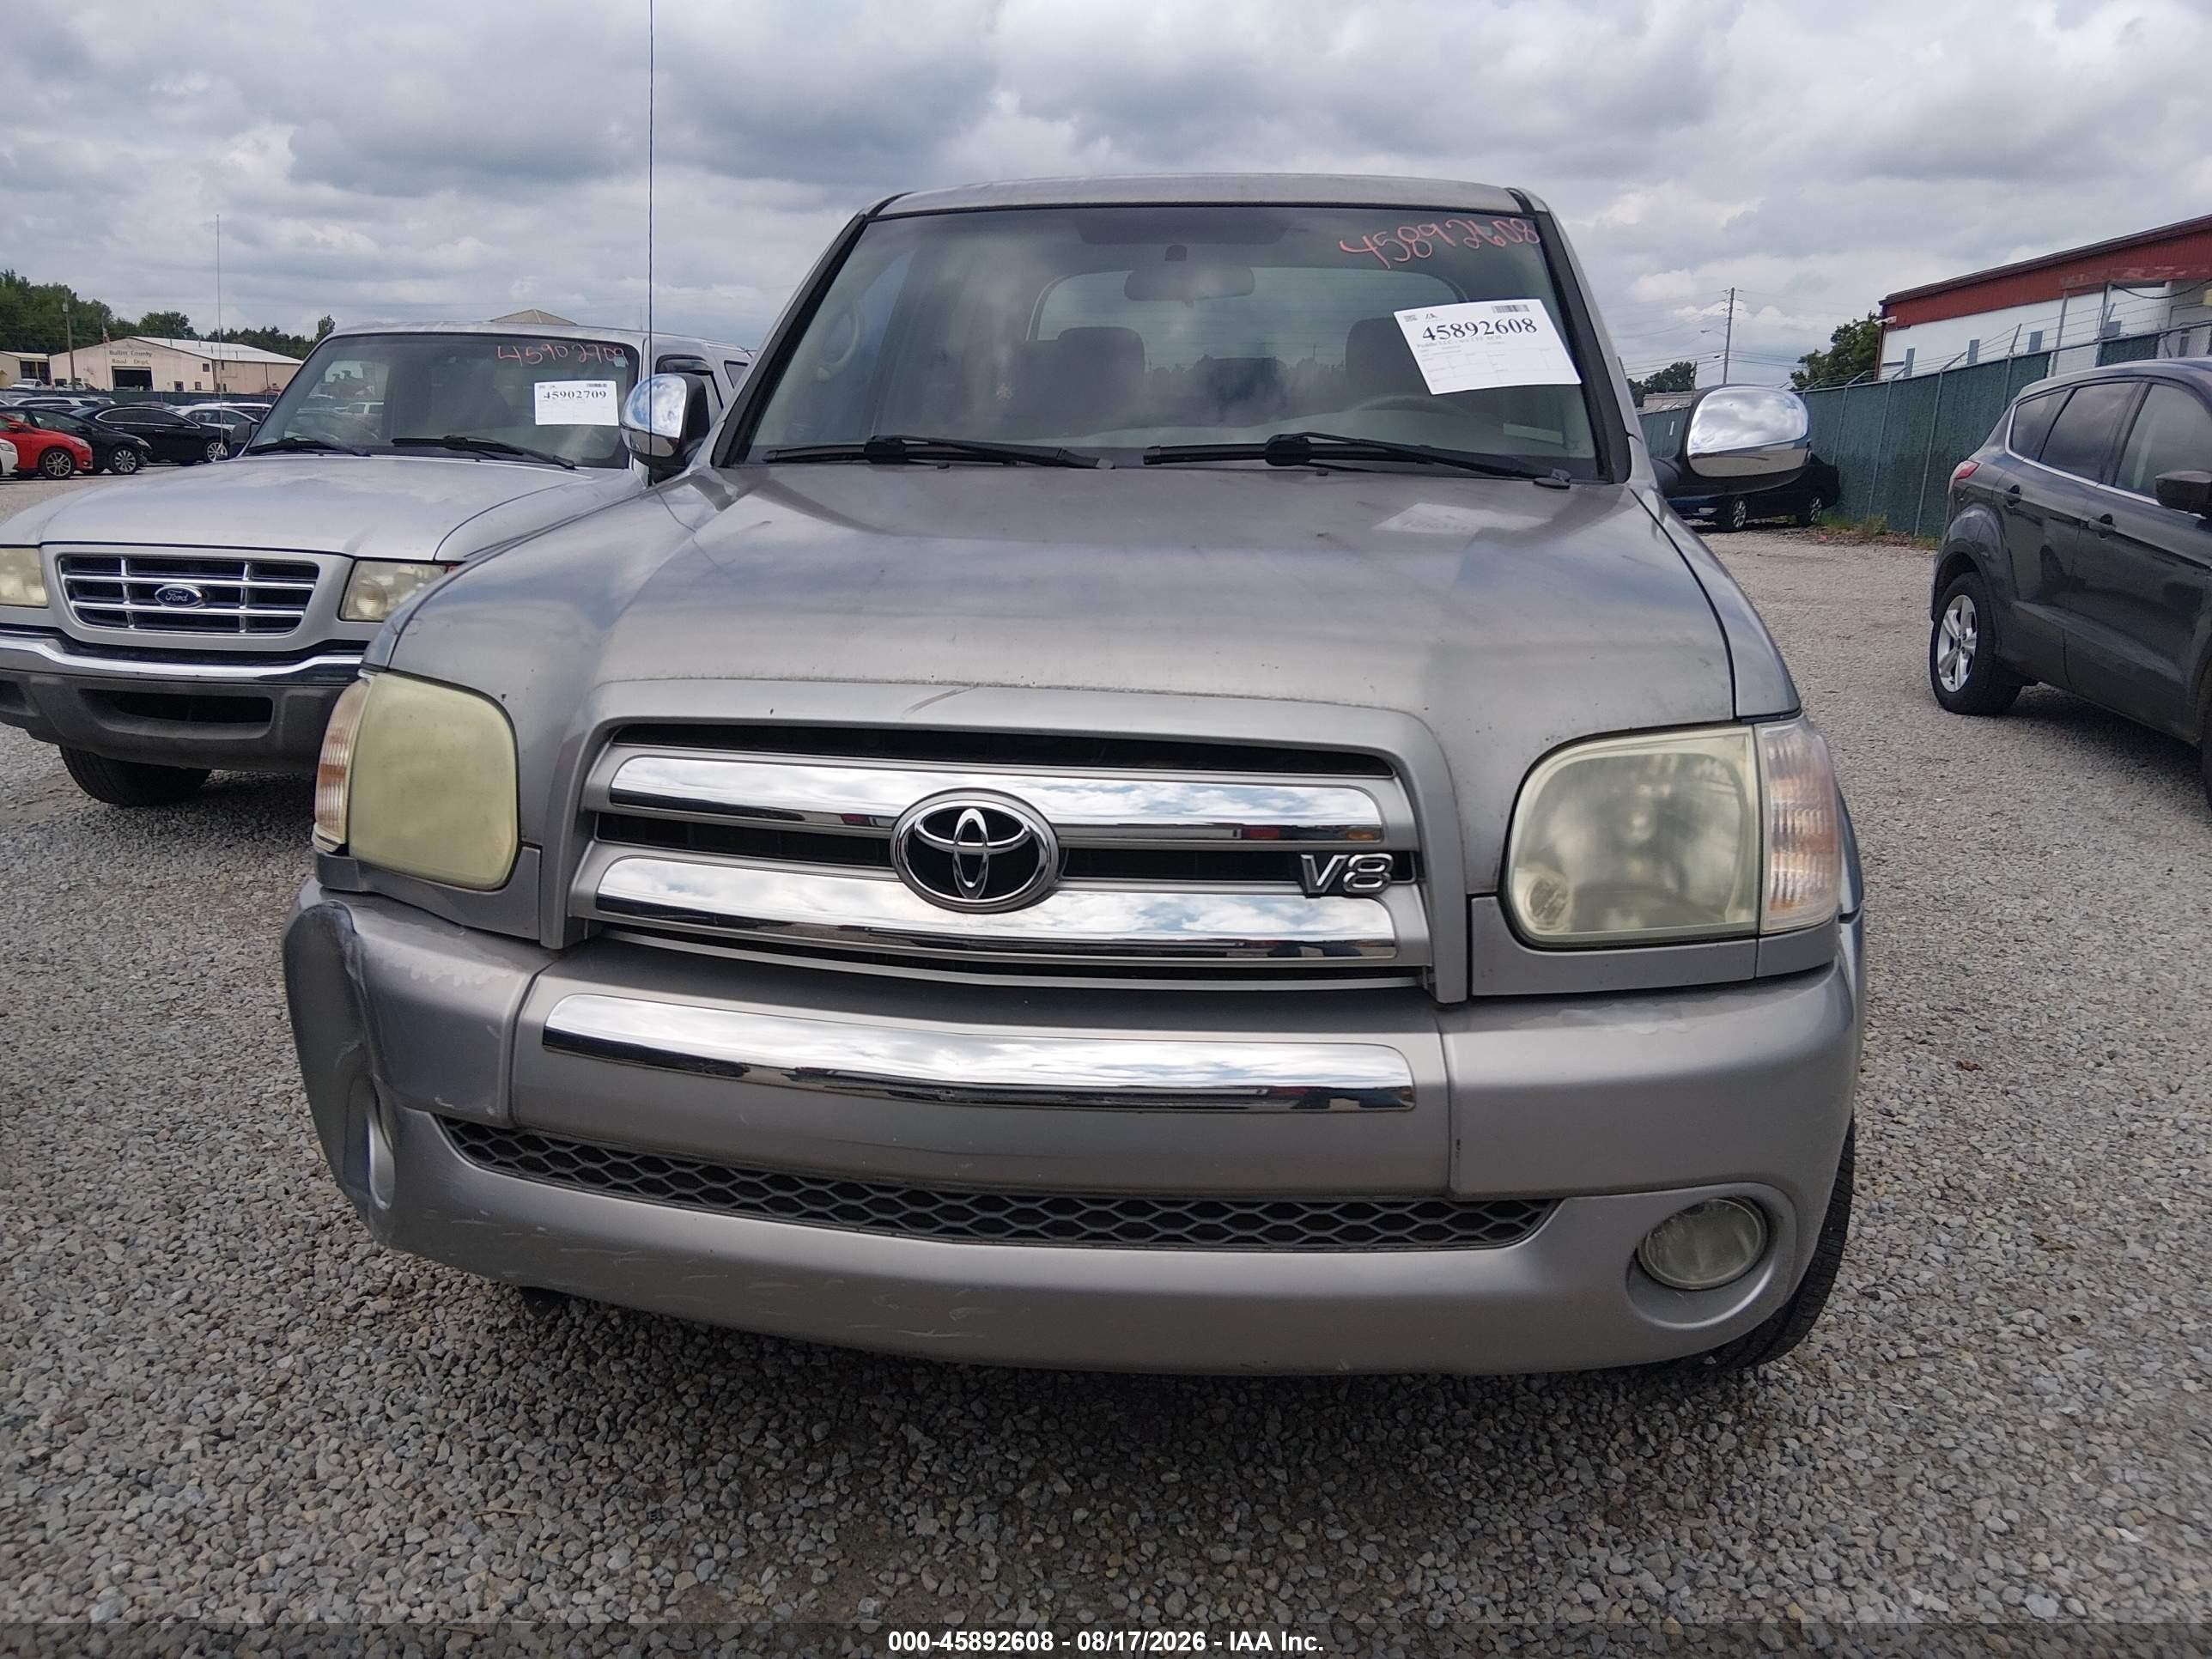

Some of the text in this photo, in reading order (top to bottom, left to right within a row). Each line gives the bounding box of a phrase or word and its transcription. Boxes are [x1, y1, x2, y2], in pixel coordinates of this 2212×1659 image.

[1339, 218, 1540, 269] 45892608
[1422, 318, 1538, 341] 45892608
[131, 349, 152, 358] County
[497, 343, 629, 367] 45902709
[544, 390, 607, 400] 45902709
[165, 589, 189, 602] Ford
[1300, 853, 1393, 894] V8
